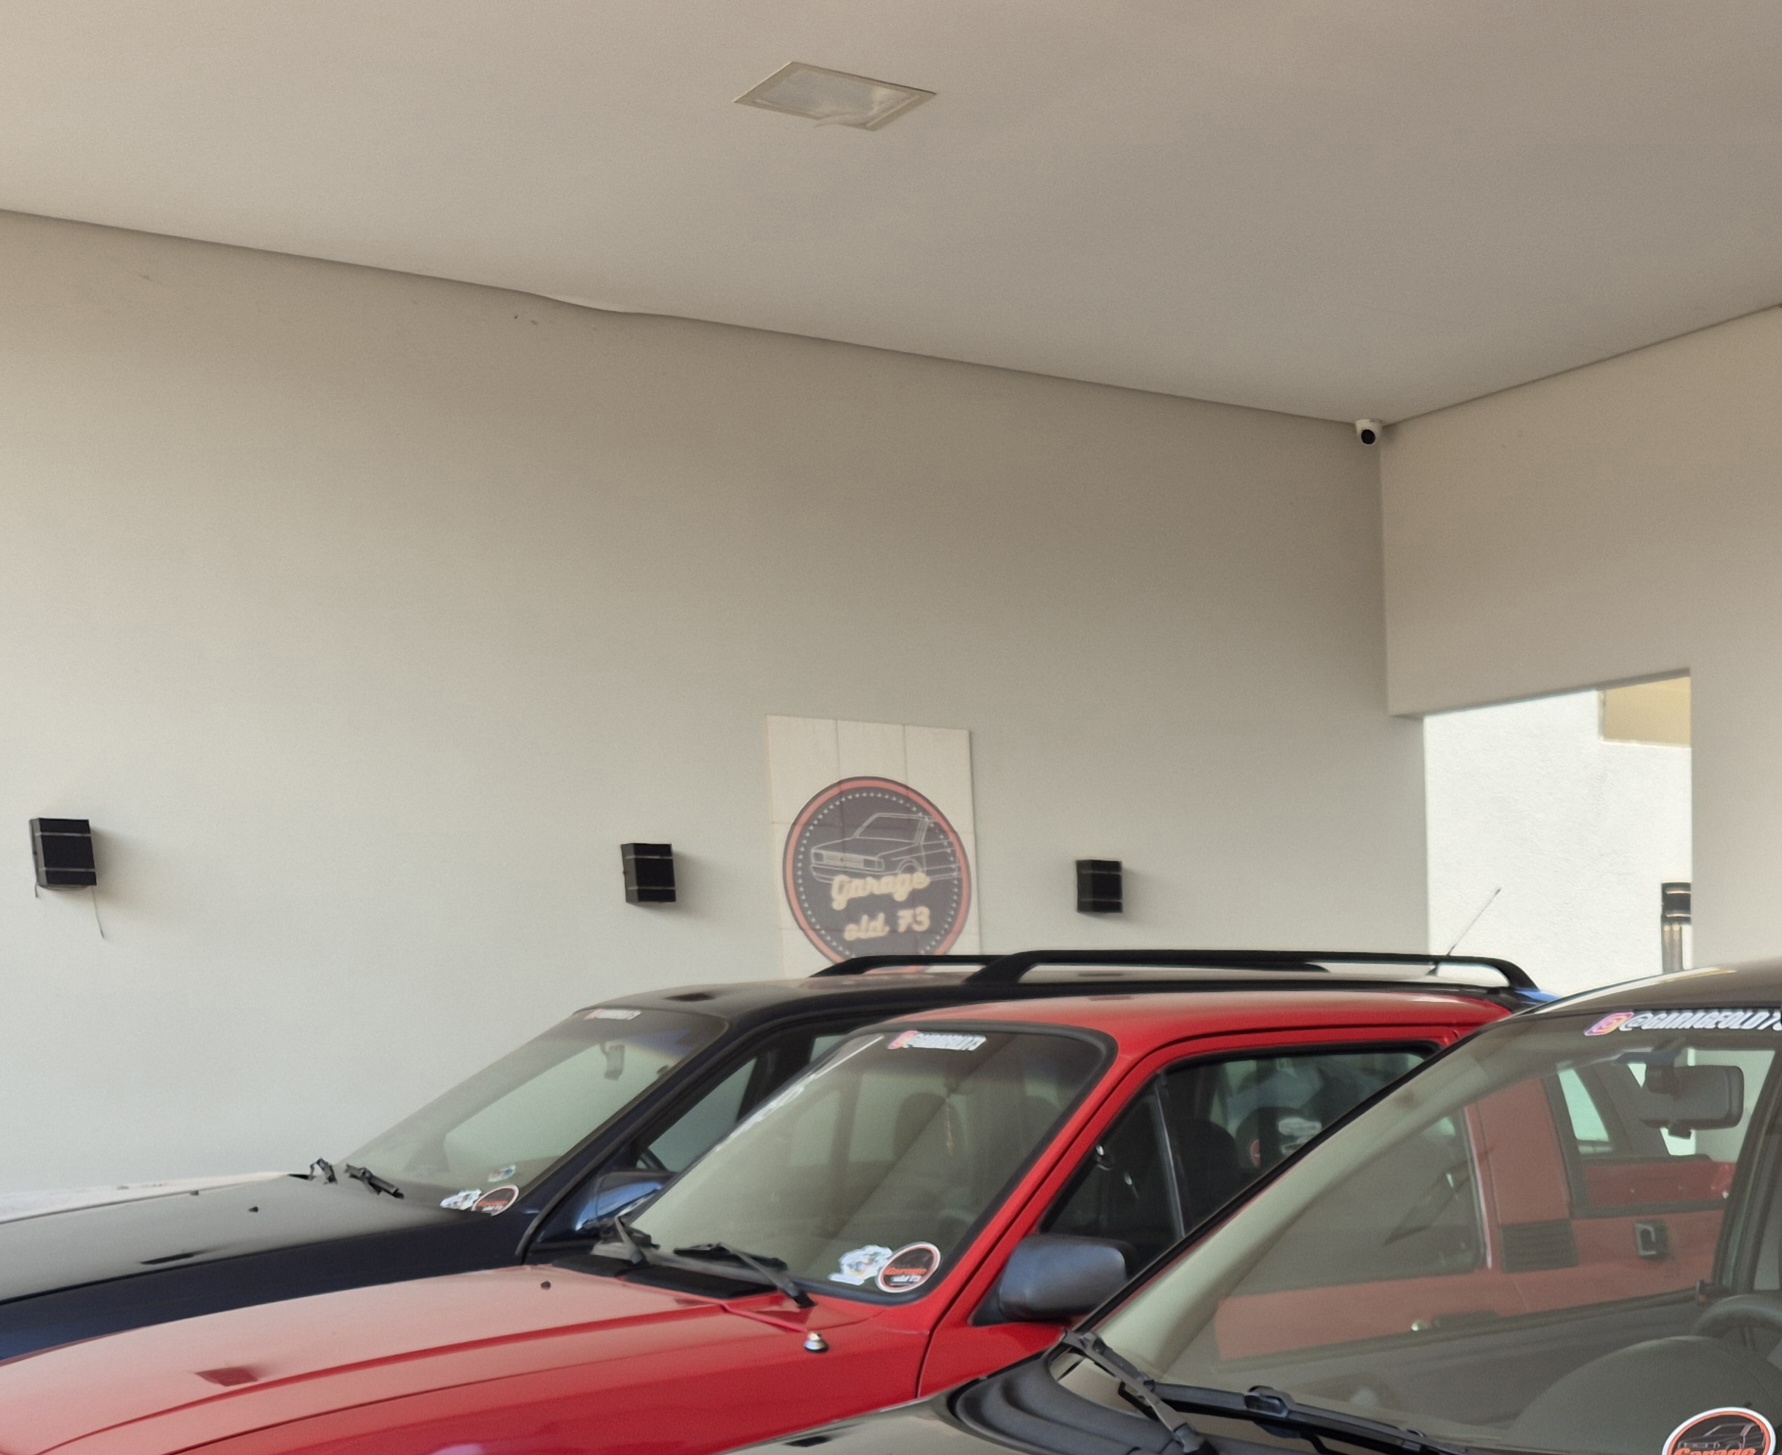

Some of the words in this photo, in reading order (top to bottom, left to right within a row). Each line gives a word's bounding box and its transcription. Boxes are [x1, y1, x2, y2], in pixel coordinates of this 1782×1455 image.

[831, 872, 930, 910] Garage
[844, 912, 890, 941] old
[897, 906, 931, 933] 73
